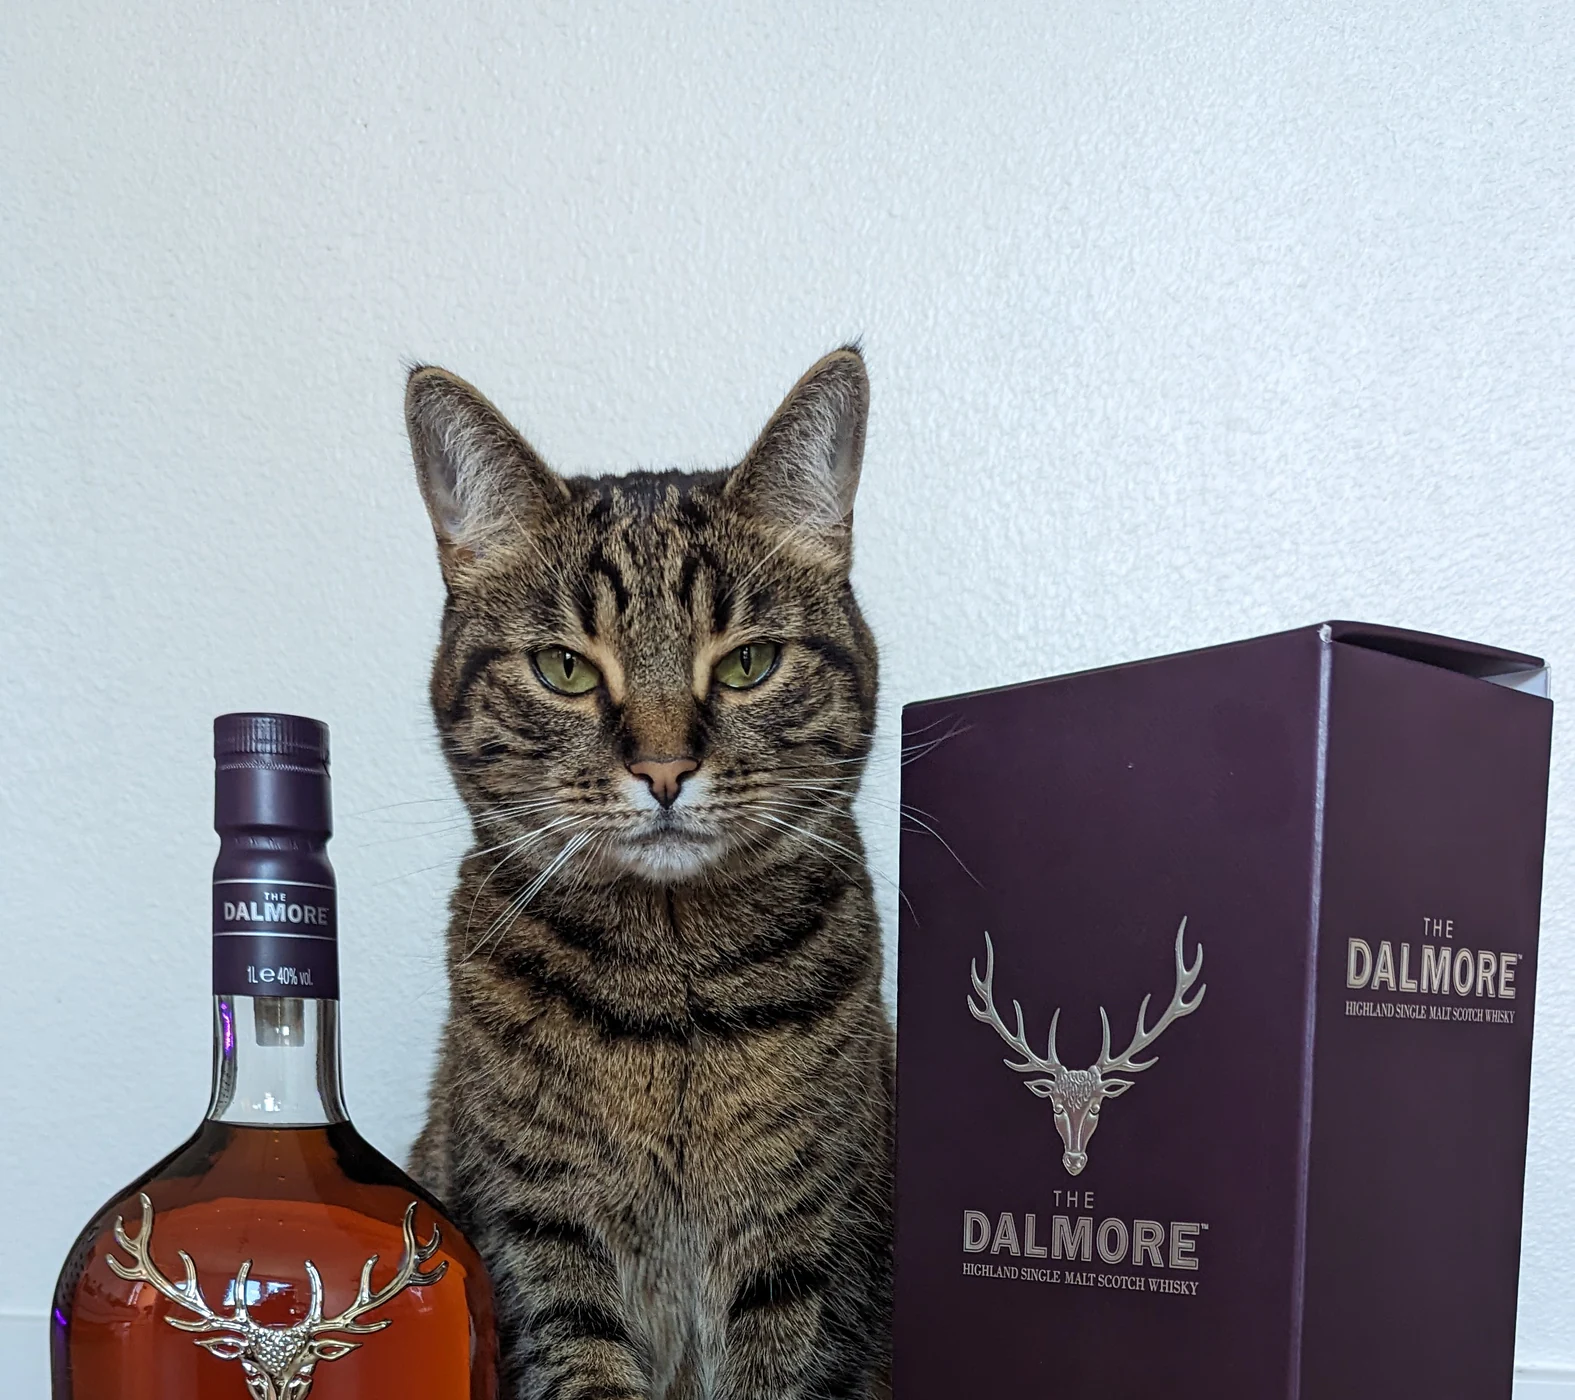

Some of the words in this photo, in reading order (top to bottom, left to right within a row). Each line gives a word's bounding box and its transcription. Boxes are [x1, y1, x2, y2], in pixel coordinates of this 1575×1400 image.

[264, 892, 286, 901] THE
[1424, 917, 1453, 939] THE
[247, 966, 258, 983] 1L
[277, 967, 297, 985] 40%
[299, 969, 313, 986] vol.
[1345, 1000, 1394, 1017] HIGHLAND
[1396, 1004, 1426, 1019] SINGLE
[1429, 1006, 1451, 1020] MALT
[1452, 1007, 1484, 1022] SCOTCH
[1485, 1009, 1515, 1024] WHISKY
[1053, 1190, 1095, 1209] THE
[962, 1263, 1018, 1280] HIGHLAND
[1020, 1267, 1061, 1283] SINGLE
[1064, 1271, 1096, 1286] MALT
[1098, 1274, 1145, 1291] SCOTCH
[1148, 1278, 1199, 1296] WHISKY
